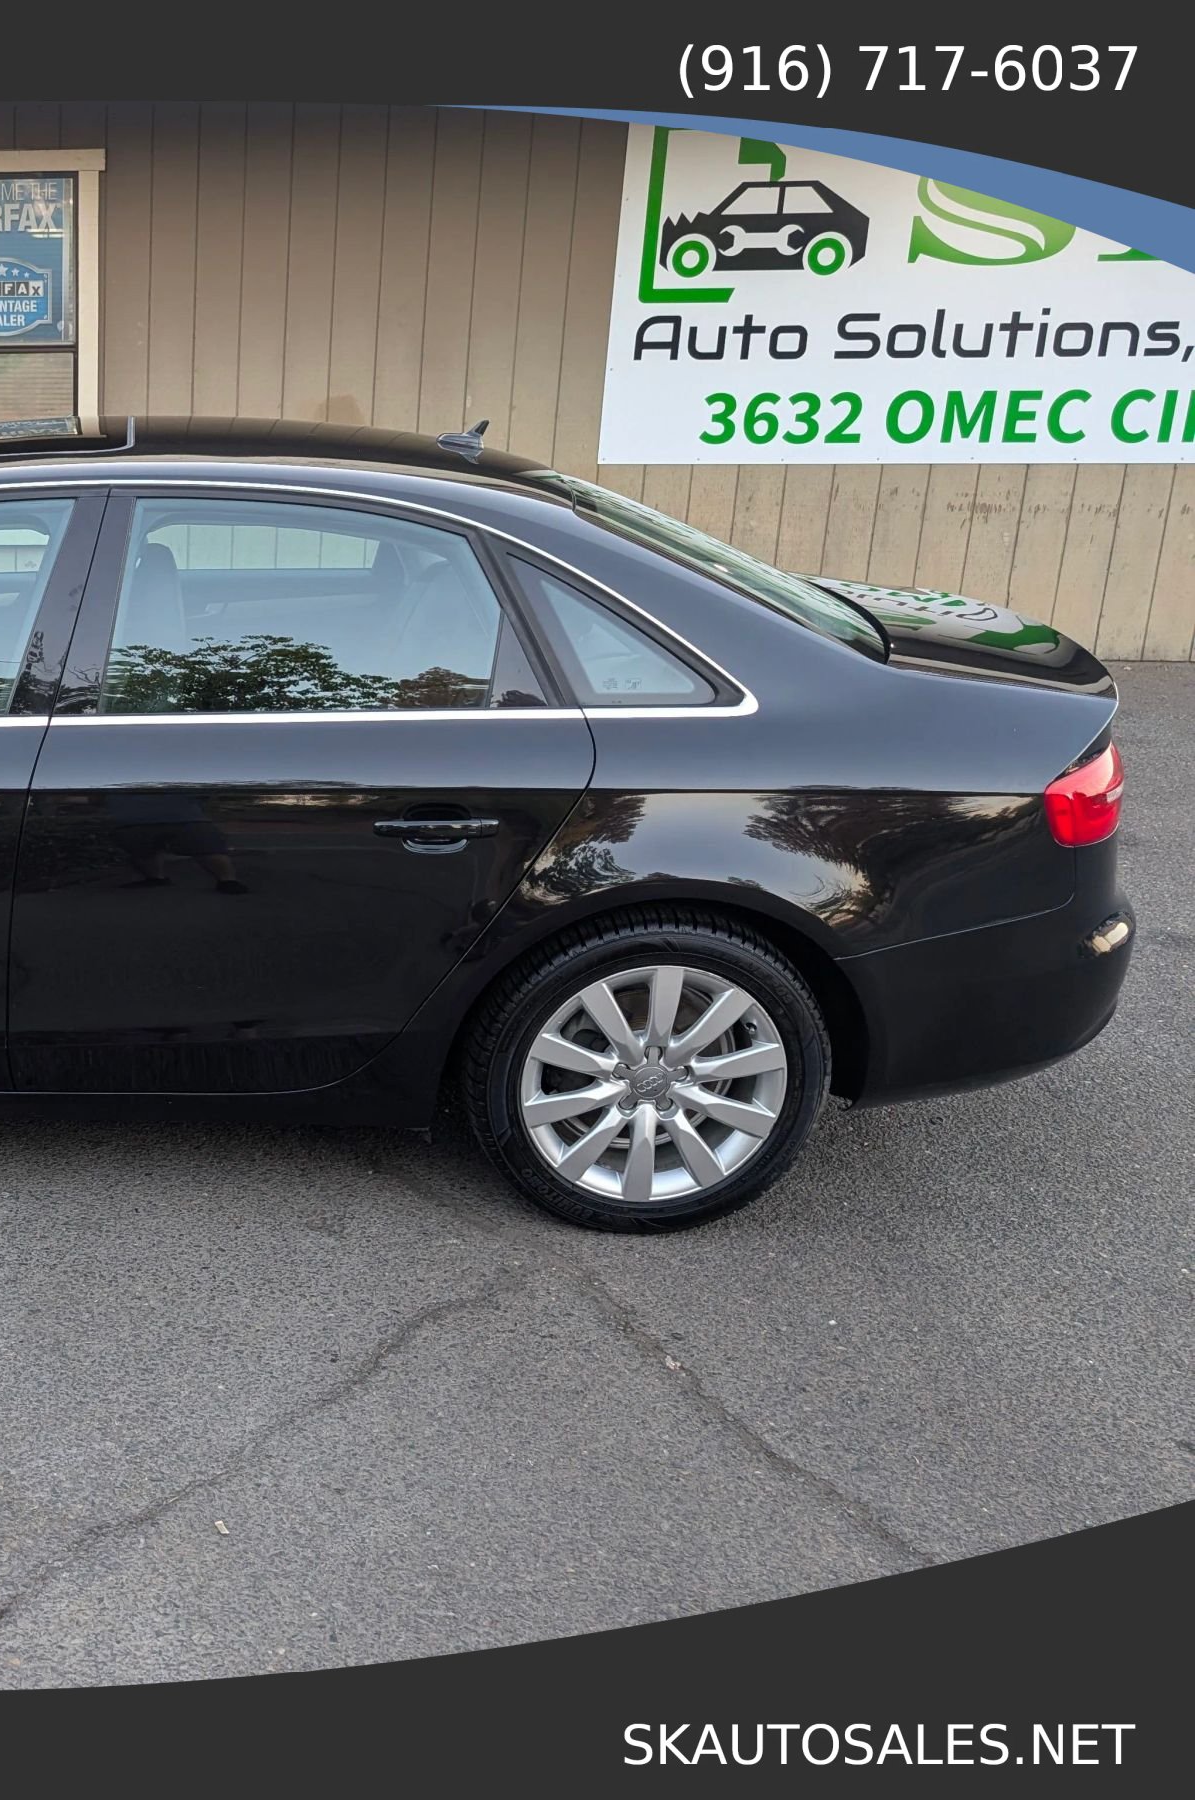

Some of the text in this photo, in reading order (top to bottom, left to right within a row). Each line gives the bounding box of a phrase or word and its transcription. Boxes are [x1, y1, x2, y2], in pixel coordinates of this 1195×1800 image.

[2, 183, 25, 201] ME
[31, 182, 58, 201] THE
[633, 308, 1195, 362] Auto Solutions,
[700, 391, 863, 444] 3632
[886, 390, 1092, 444] OMEC
